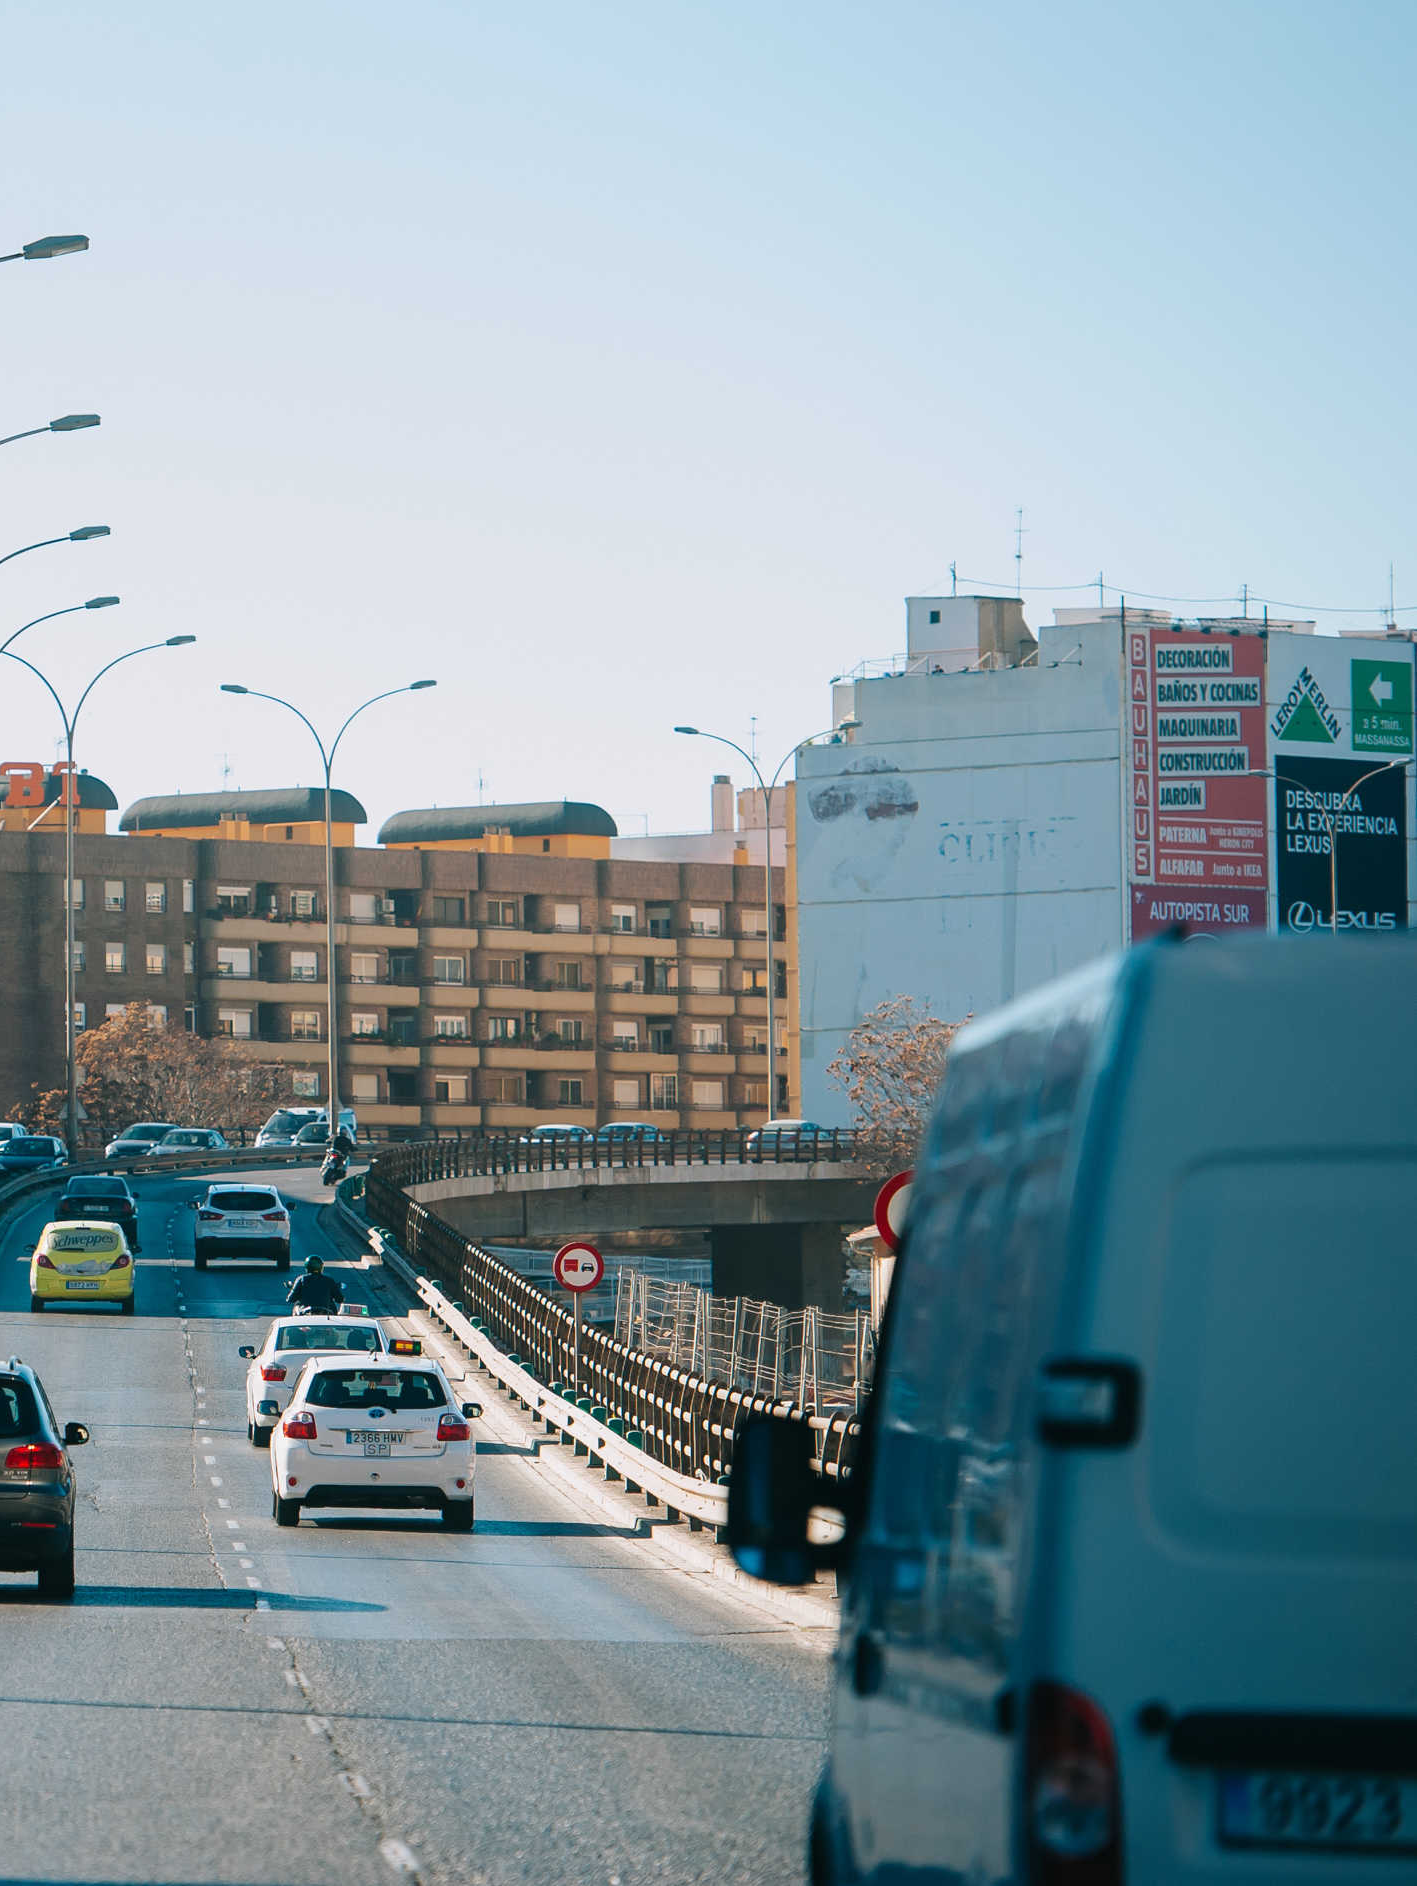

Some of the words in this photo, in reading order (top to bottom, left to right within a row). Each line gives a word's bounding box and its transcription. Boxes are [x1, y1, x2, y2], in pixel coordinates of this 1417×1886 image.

[1157, 645, 1230, 668] DECORACIÓN
[1158, 680, 1198, 702] BAÑOS
[1200, 683, 1209, 701] Y
[1210, 683, 1258, 701] COCINAS
[1299, 665, 1342, 739] MERLIN
[1270, 679, 1304, 738] LEROY
[1159, 717, 1238, 737] MAQUINARIA
[1371, 716, 1378, 729] 5
[1354, 733, 1410, 747] MASSANASSA
[1132, 638, 1150, 871] BAUHAUS
[1159, 747, 1245, 771] CONSTRUCCIÓN
[1160, 782, 1202, 806] JARDÍN
[1286, 790, 1362, 812] DESCUBRA
[1159, 826, 1207, 844] PATERNA
[1286, 812, 1304, 831] LA
[1308, 813, 1398, 836] EXPERIENCIA
[1286, 834, 1332, 855] LEXUS
[1160, 859, 1204, 876] ALFAFAR
[1212, 863, 1235, 877] Junto
[1243, 864, 1262, 877] IKEA
[1150, 901, 1221, 922] AUTOPISTA
[1223, 904, 1250, 923] SUR
[1317, 909, 1397, 930] LEXUS
[53, 1234, 114, 1248] Schweppes
[383, 1432, 404, 1443] HMV
